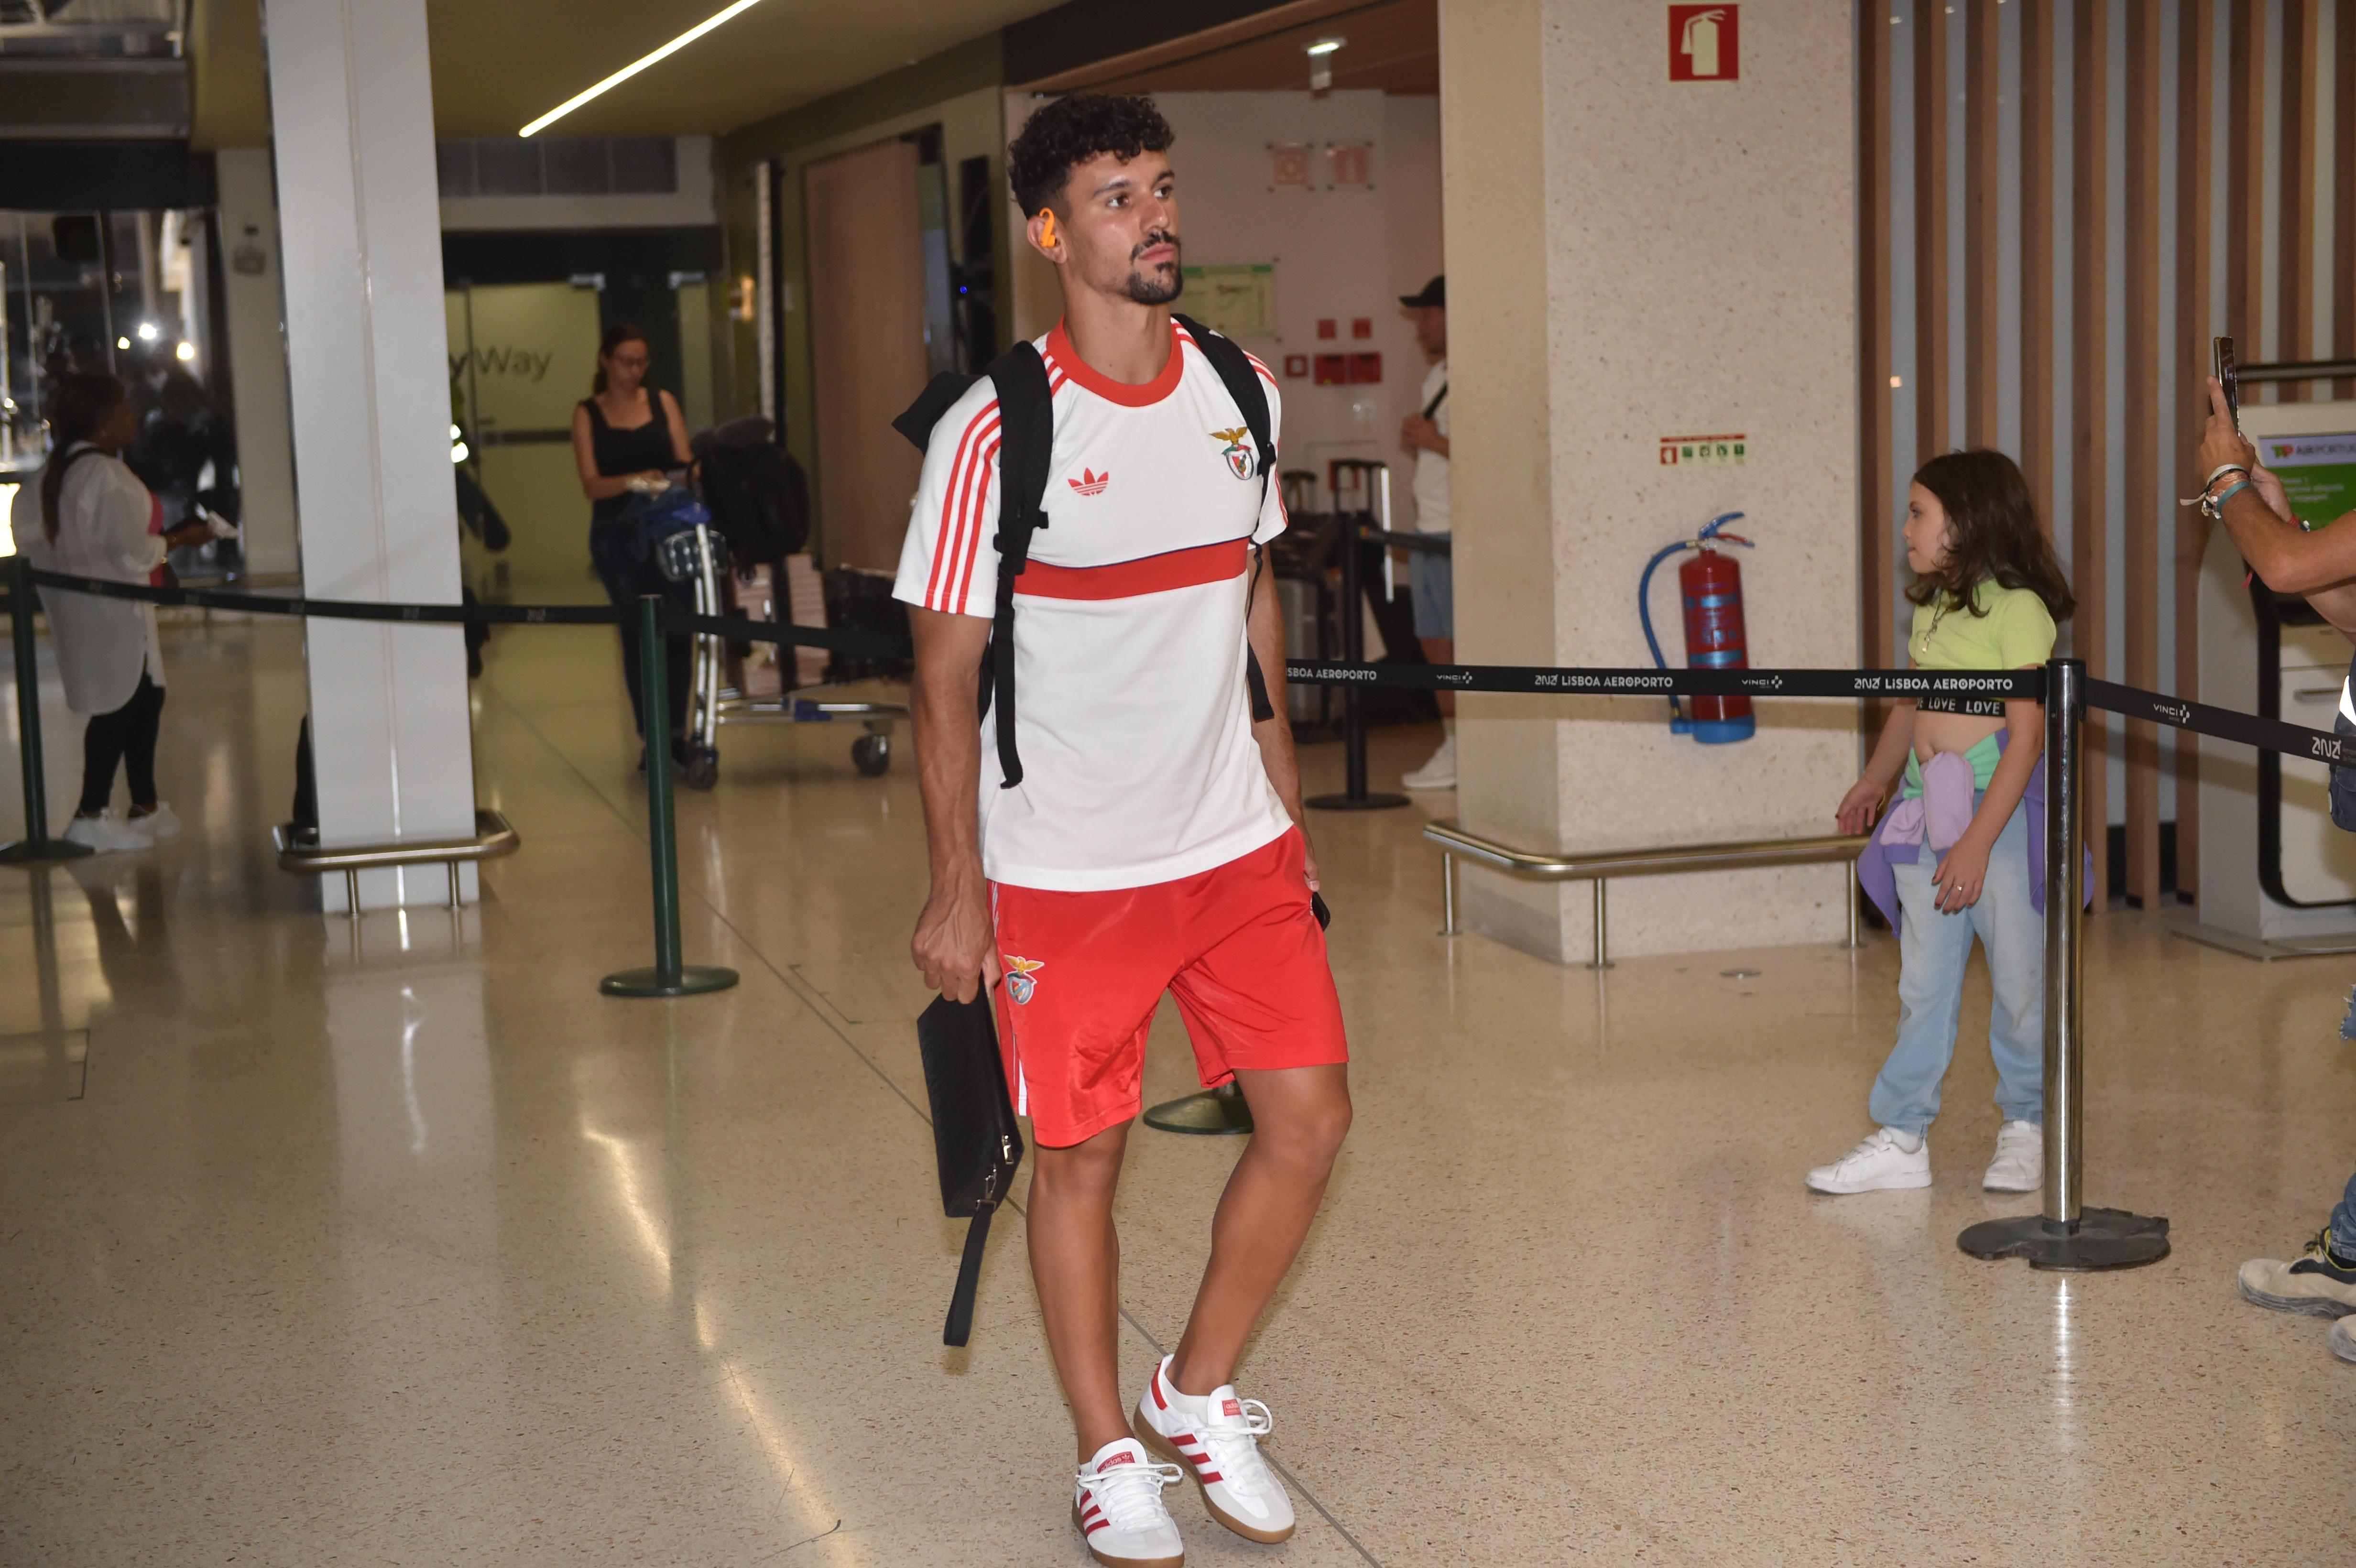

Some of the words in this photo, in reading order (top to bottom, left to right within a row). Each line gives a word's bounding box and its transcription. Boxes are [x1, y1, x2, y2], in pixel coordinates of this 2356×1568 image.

[1316, 668, 1377, 681] AEROPORTO
[1604, 676, 1673, 687] AEROPORTO
[1933, 678, 2013, 690] AEROPORTO
[1928, 697, 1956, 712] LOVE
[1965, 700, 2000, 715] LOVE
[2153, 703, 2178, 717] VINCI
